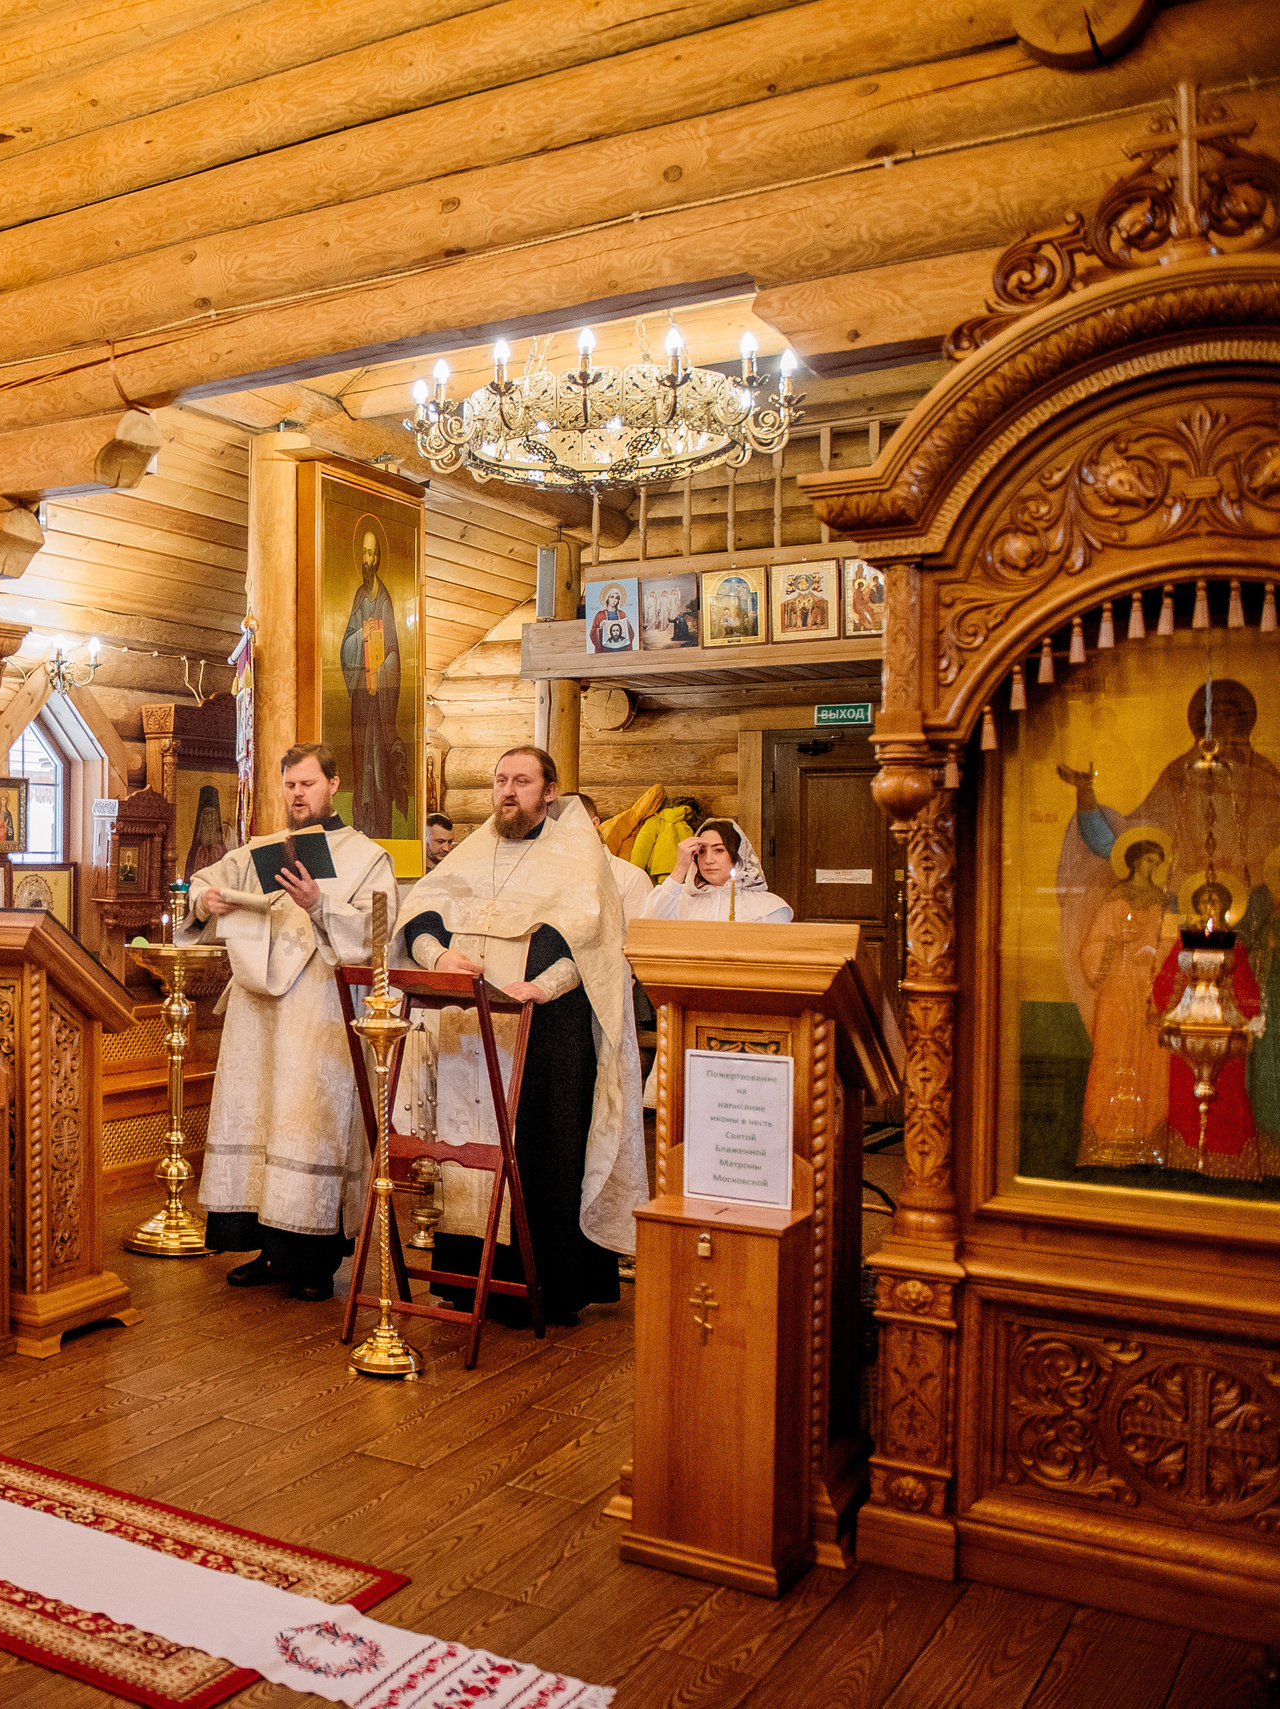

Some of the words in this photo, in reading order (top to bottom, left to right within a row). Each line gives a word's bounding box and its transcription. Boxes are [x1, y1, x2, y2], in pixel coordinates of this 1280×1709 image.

[821, 708, 865, 720] ВЫХОД
[706, 1070, 778, 1084] Пожертвование
[718, 1101, 766, 1112] написание
[710, 1115, 739, 1123] иконы
[748, 1119, 774, 1128] честь
[725, 1131, 757, 1141] Святой
[715, 1144, 767, 1157] Блаженной
[719, 1159, 762, 1171] Матроны
[712, 1173, 769, 1187] Московской
